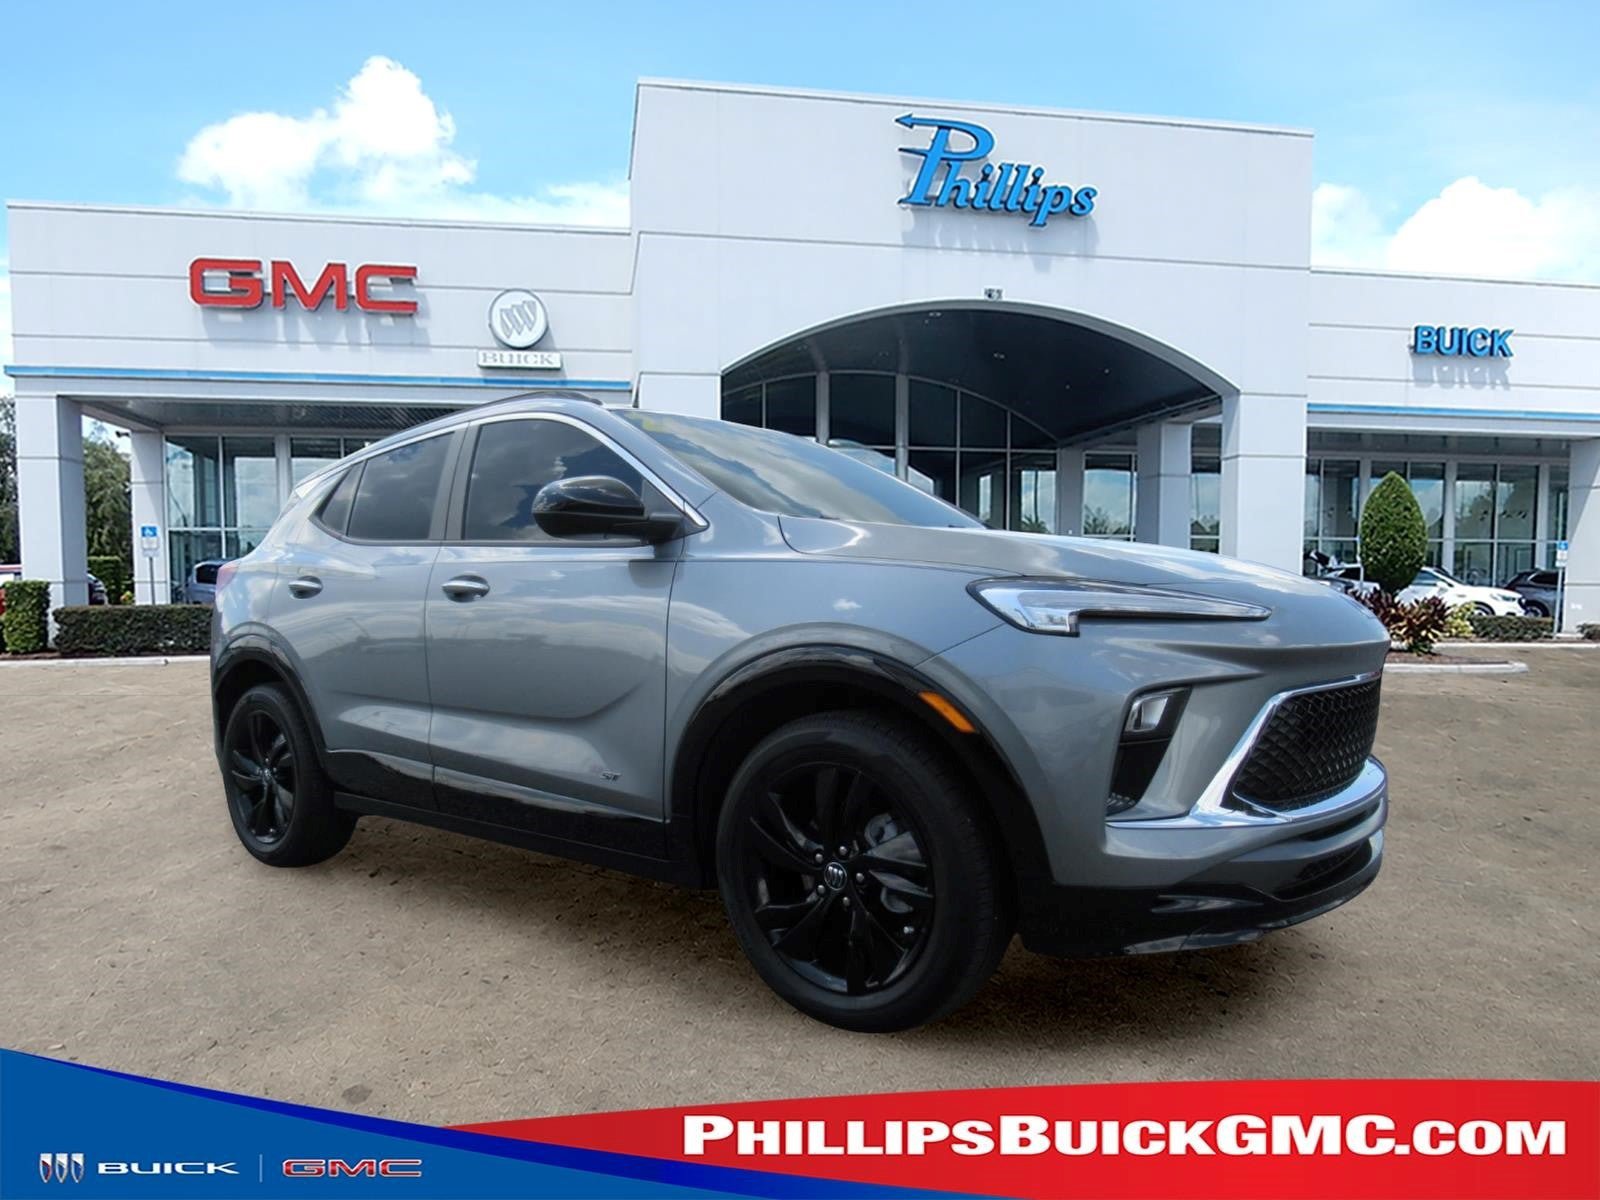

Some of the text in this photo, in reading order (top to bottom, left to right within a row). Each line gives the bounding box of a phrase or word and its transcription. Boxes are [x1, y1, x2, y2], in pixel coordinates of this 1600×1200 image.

[894, 114, 1098, 227] Phillips
[190, 257, 418, 315] GMC
[482, 352, 555, 365] BUICK
[1413, 325, 1514, 357] BUICK
